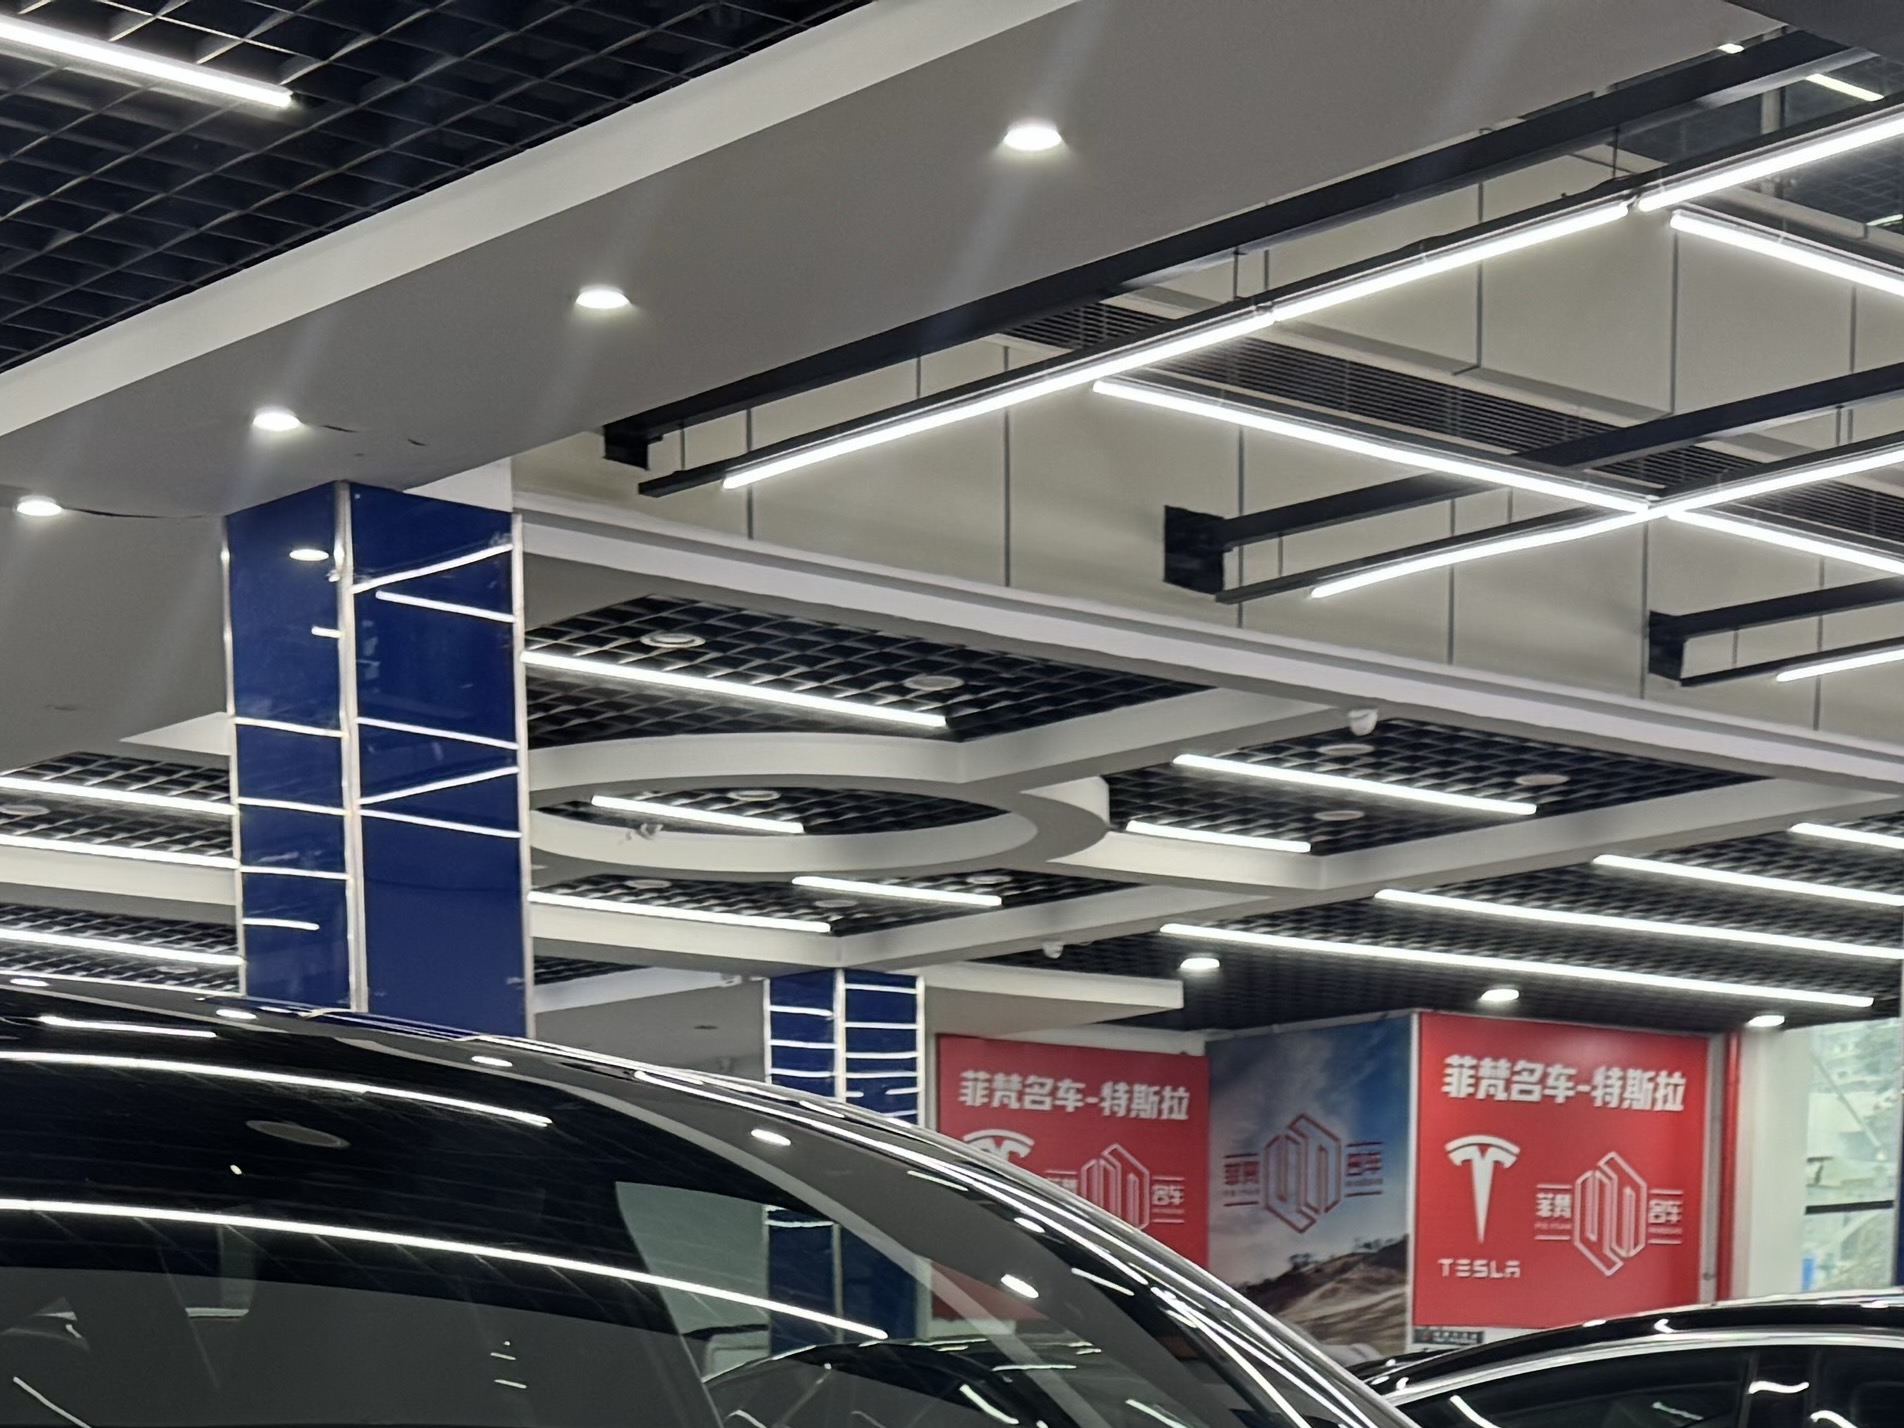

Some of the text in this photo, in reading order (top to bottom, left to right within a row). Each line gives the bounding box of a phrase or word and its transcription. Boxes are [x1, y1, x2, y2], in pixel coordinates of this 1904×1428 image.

[959, 1069, 1191, 1121] 菲梵名车-特斯拉
[1441, 1054, 1687, 1112] 菲梵名车-特斯拉
[1437, 1258, 1521, 1279] TESLA
